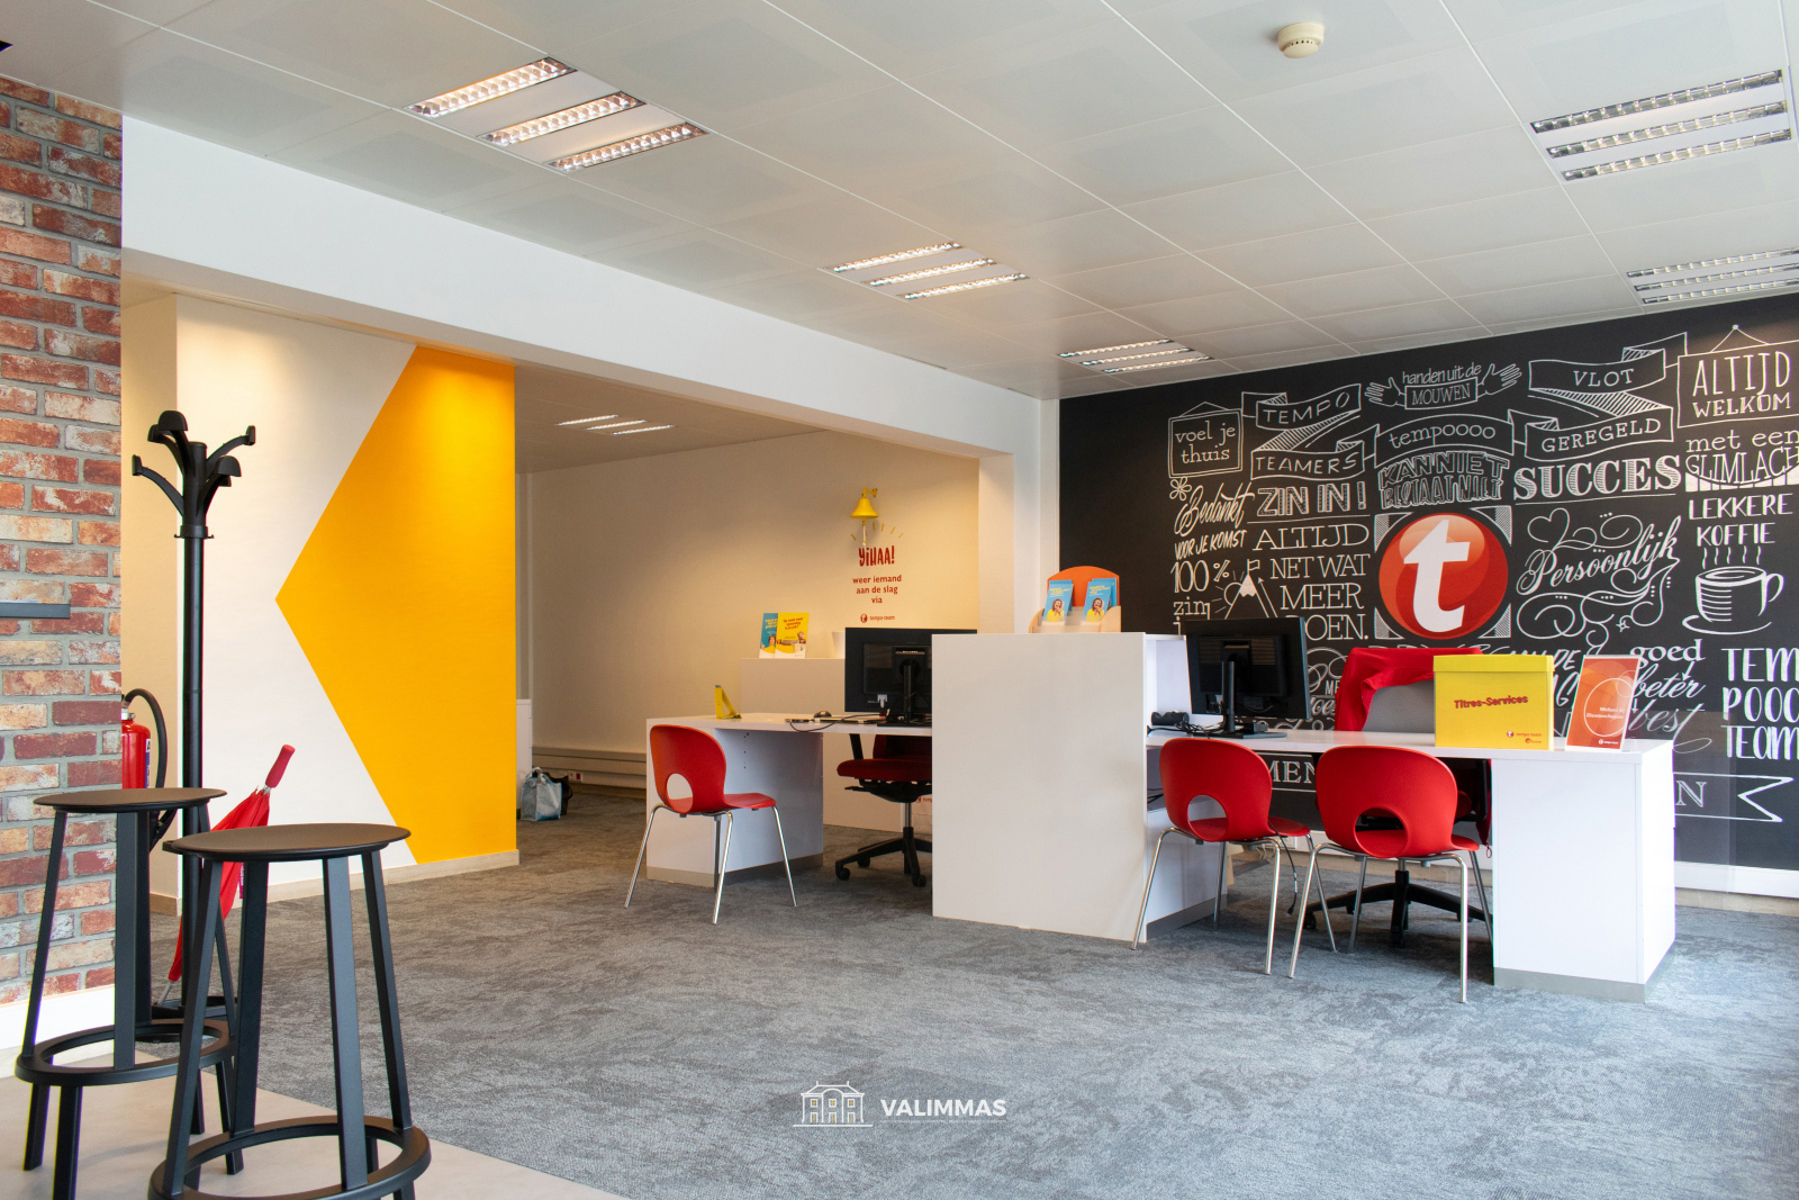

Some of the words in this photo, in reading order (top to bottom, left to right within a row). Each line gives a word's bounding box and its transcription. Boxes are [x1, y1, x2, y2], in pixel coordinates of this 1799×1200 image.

[1402, 367, 1445, 384] handen
[1447, 365, 1464, 381] uit
[1465, 361, 1482, 377] de
[1573, 368, 1634, 387] VLOT
[1692, 350, 1791, 397] ALTIJD
[1411, 382, 1471, 406] MOUWEN
[1692, 391, 1791, 418] WELKOM
[1263, 391, 1350, 425] TEMPO
[1175, 420, 1213, 443] voel
[1219, 422, 1236, 446] je
[1389, 424, 1496, 449] tempoooo
[1541, 418, 1661, 453] GEREGELD
[1685, 429, 1741, 453] met
[1751, 430, 1799, 448] een
[1181, 443, 1230, 464] thuis
[1255, 452, 1359, 474] TEAMERS
[1513, 455, 1682, 501] SUCCES
[1174, 482, 1256, 537] Bedankt
[1256, 486, 1310, 517] ZIN
[1689, 493, 1793, 520] LEKKERE
[1174, 538, 1195, 560] VOOR
[1196, 535, 1209, 554] JE
[1210, 530, 1247, 551] KOMST
[1252, 523, 1370, 551] ALTIJD
[1697, 522, 1776, 547] KOFFIE
[1270, 556, 1315, 579] NET
[1317, 553, 1371, 578] WAT
[1516, 515, 1682, 596] Persoonlijk
[871, 586, 881, 594] de
[883, 585, 898, 595] slag
[873, 574, 902, 584] iemand
[1173, 597, 1211, 620] zin
[1279, 582, 1365, 610] MEER
[1286, 613, 1369, 641] OEN.
[1629, 639, 1706, 669] goed
[1633, 663, 1706, 698] beter
[1453, 695, 1528, 709] Titres-Services
